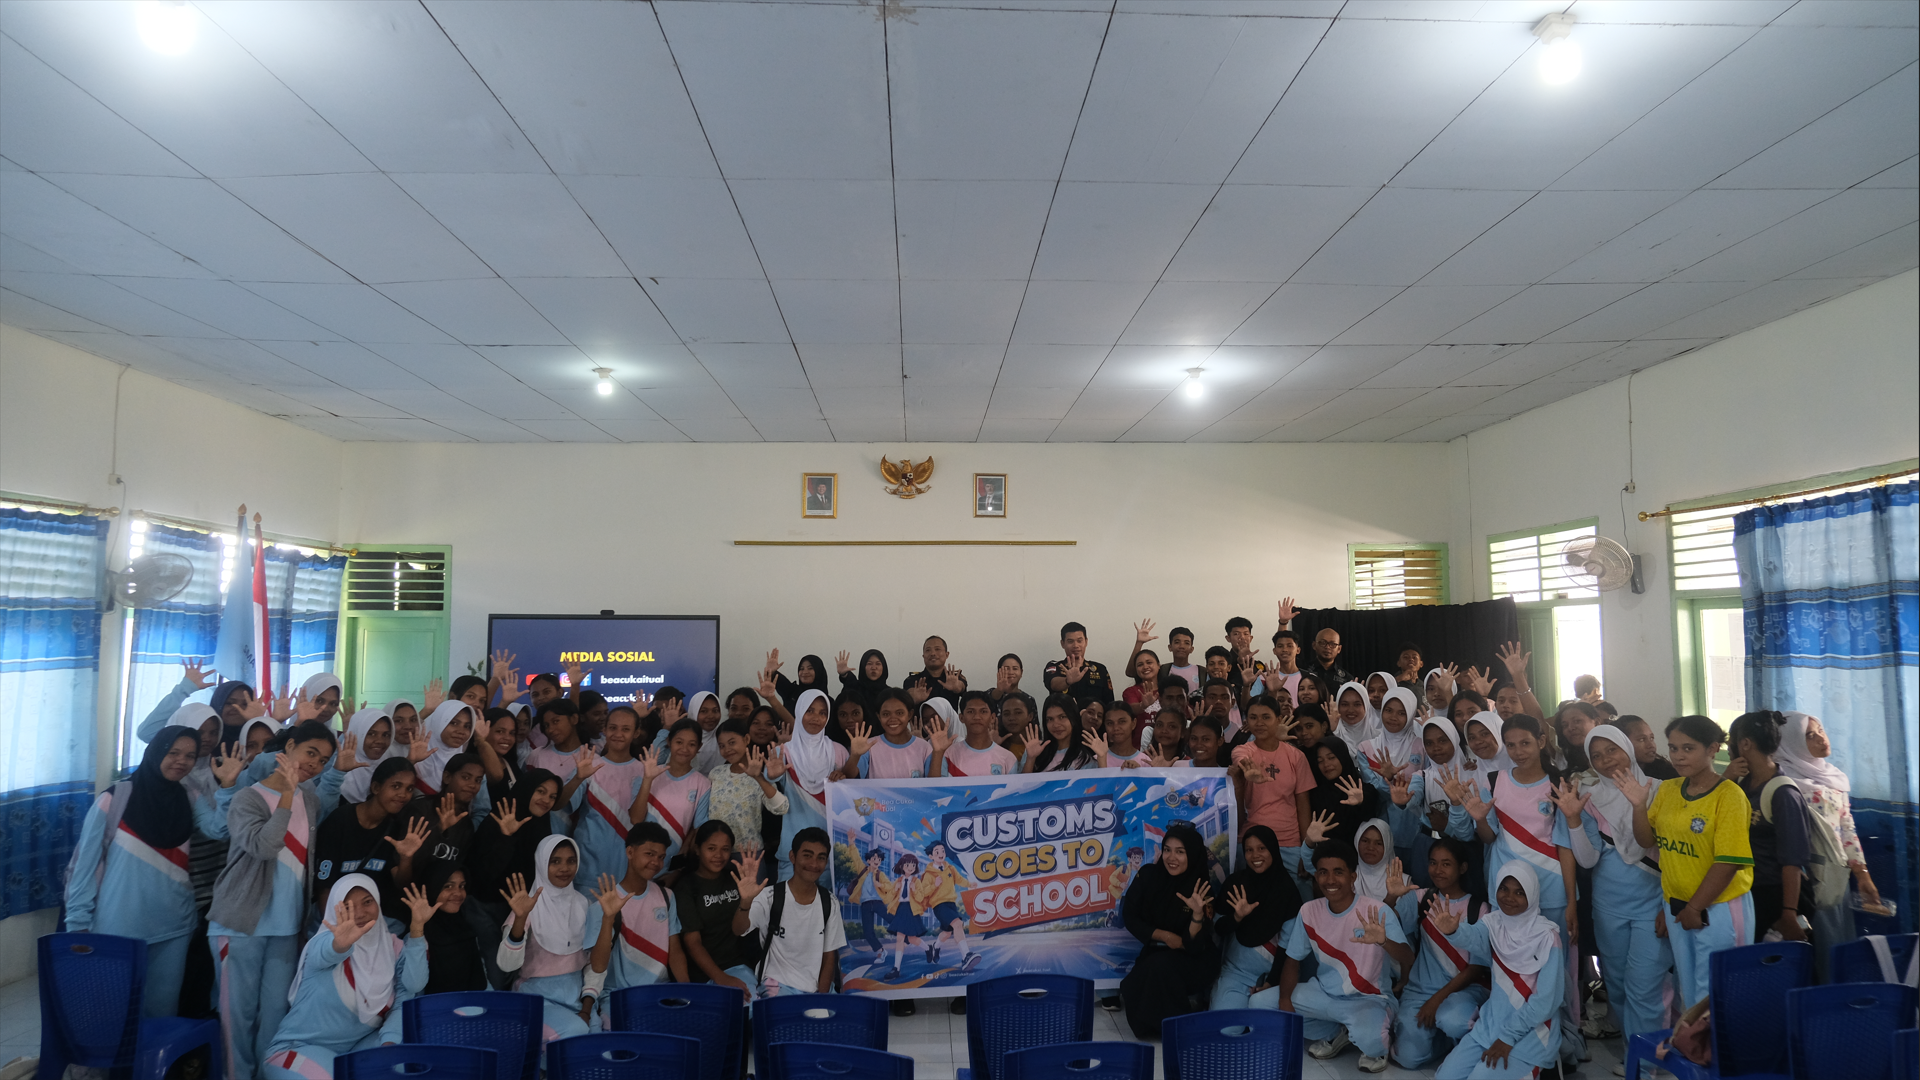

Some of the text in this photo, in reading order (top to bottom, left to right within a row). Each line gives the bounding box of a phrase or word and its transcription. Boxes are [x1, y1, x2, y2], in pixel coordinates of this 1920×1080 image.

[607, 651, 655, 662] SOSIAL
[600, 675, 665, 684] beacukaitual
[946, 799, 1116, 852] CUSTOMS
[1656, 835, 1700, 859] BRAZIL
[317, 859, 333, 880] 9
[973, 838, 1104, 882] GOES TO
[974, 873, 1110, 926] SCHOOL
